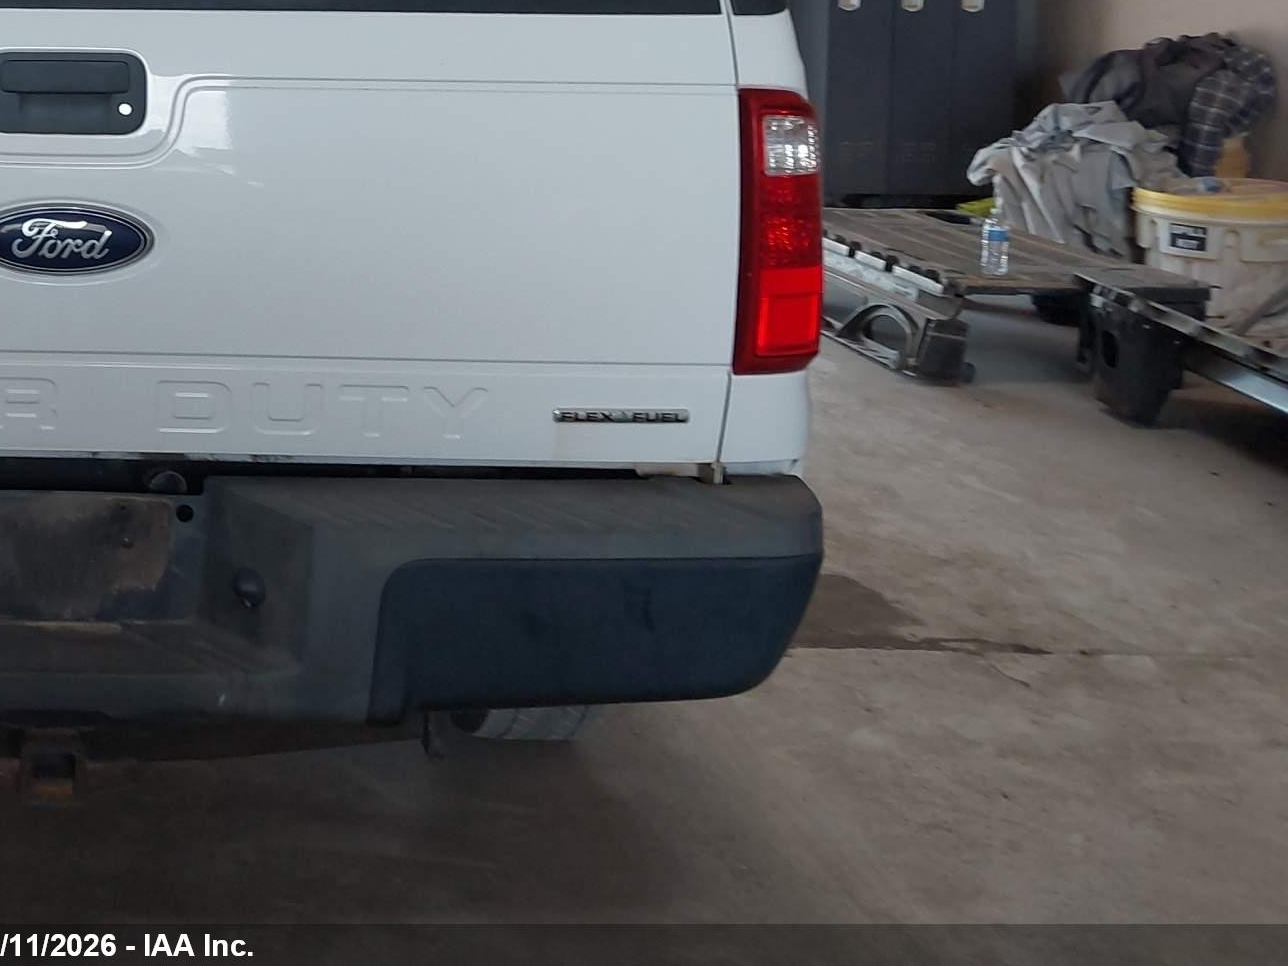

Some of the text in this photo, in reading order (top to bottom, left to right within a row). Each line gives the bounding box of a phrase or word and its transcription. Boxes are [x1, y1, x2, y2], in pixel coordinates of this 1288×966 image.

[0, 217, 113, 261] Ford
[154, 380, 490, 440] DUTY
[560, 410, 689, 423] FLEX FUEL
